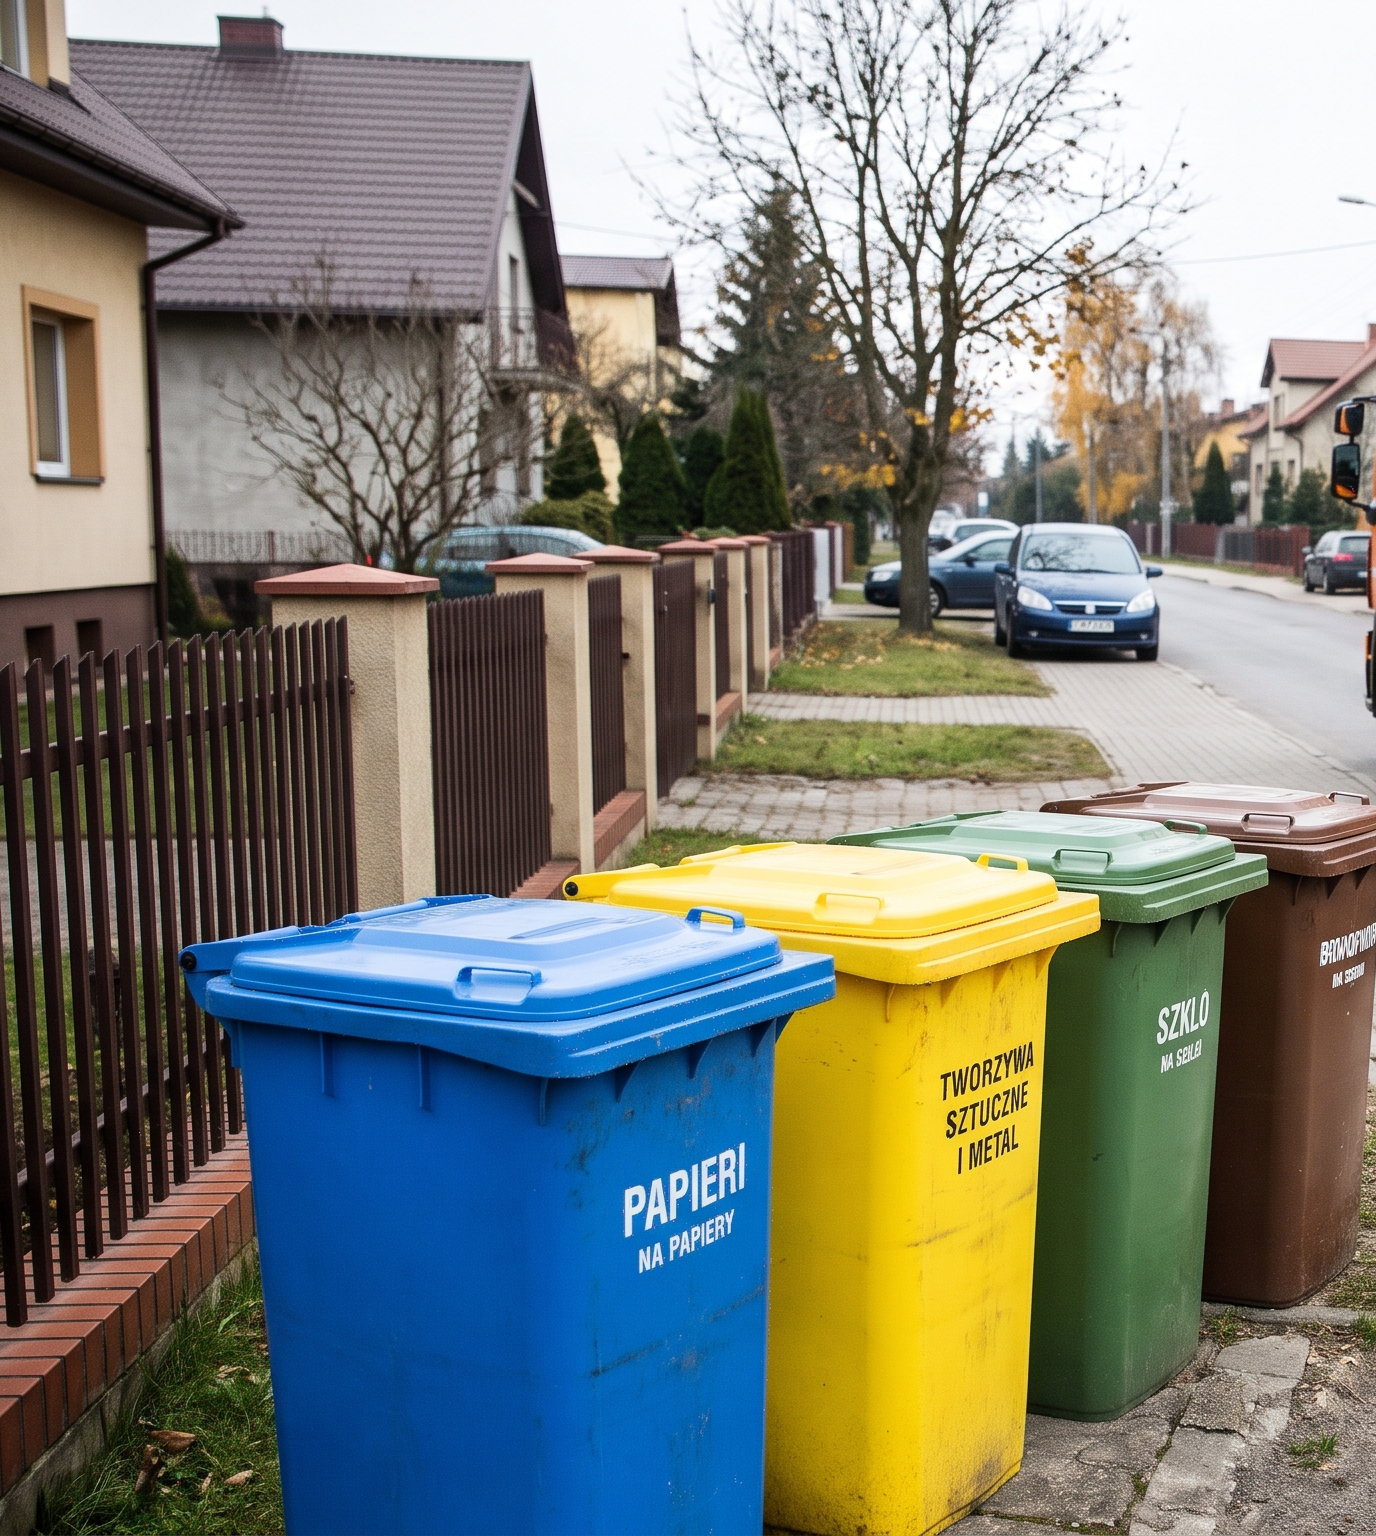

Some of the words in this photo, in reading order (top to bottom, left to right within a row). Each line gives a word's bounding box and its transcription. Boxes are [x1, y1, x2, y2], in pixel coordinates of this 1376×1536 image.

[940, 1041, 1034, 1101] TWORZYWA
[945, 1080, 1029, 1140] SZTUCZNE
[957, 1146, 963, 1175] I
[968, 1124, 1019, 1171] METAL
[624, 1142, 746, 1238] PAPIERI
[638, 1242, 664, 1274] NA
[669, 1208, 735, 1262] PAPIERY
